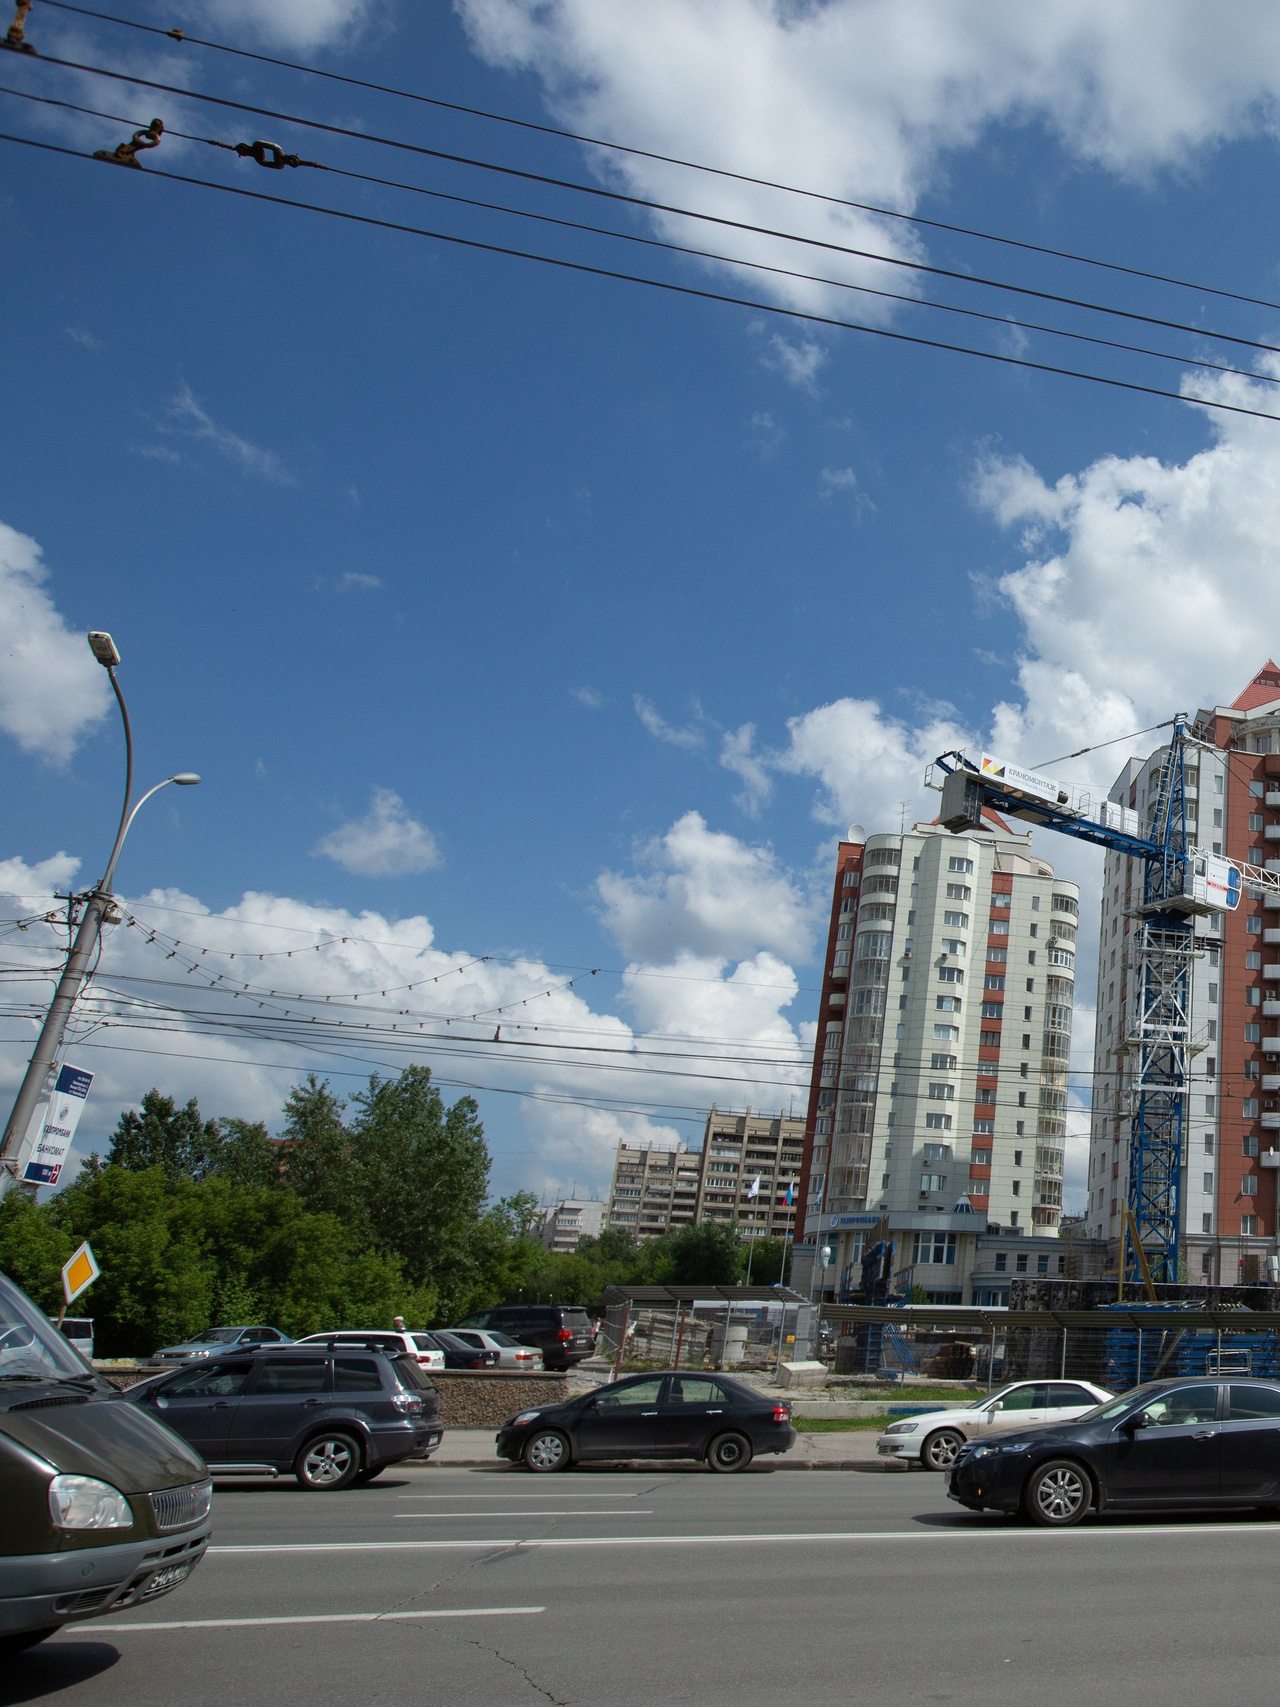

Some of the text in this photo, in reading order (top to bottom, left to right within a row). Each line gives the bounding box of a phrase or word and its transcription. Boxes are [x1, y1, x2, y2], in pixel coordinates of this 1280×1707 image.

[1008, 767, 1057, 792] КРАНОМОНТАЖ
[44, 1124, 71, 1138] ГАЗПРОМБАНК
[36, 1143, 65, 1156] БАНКОМАТ
